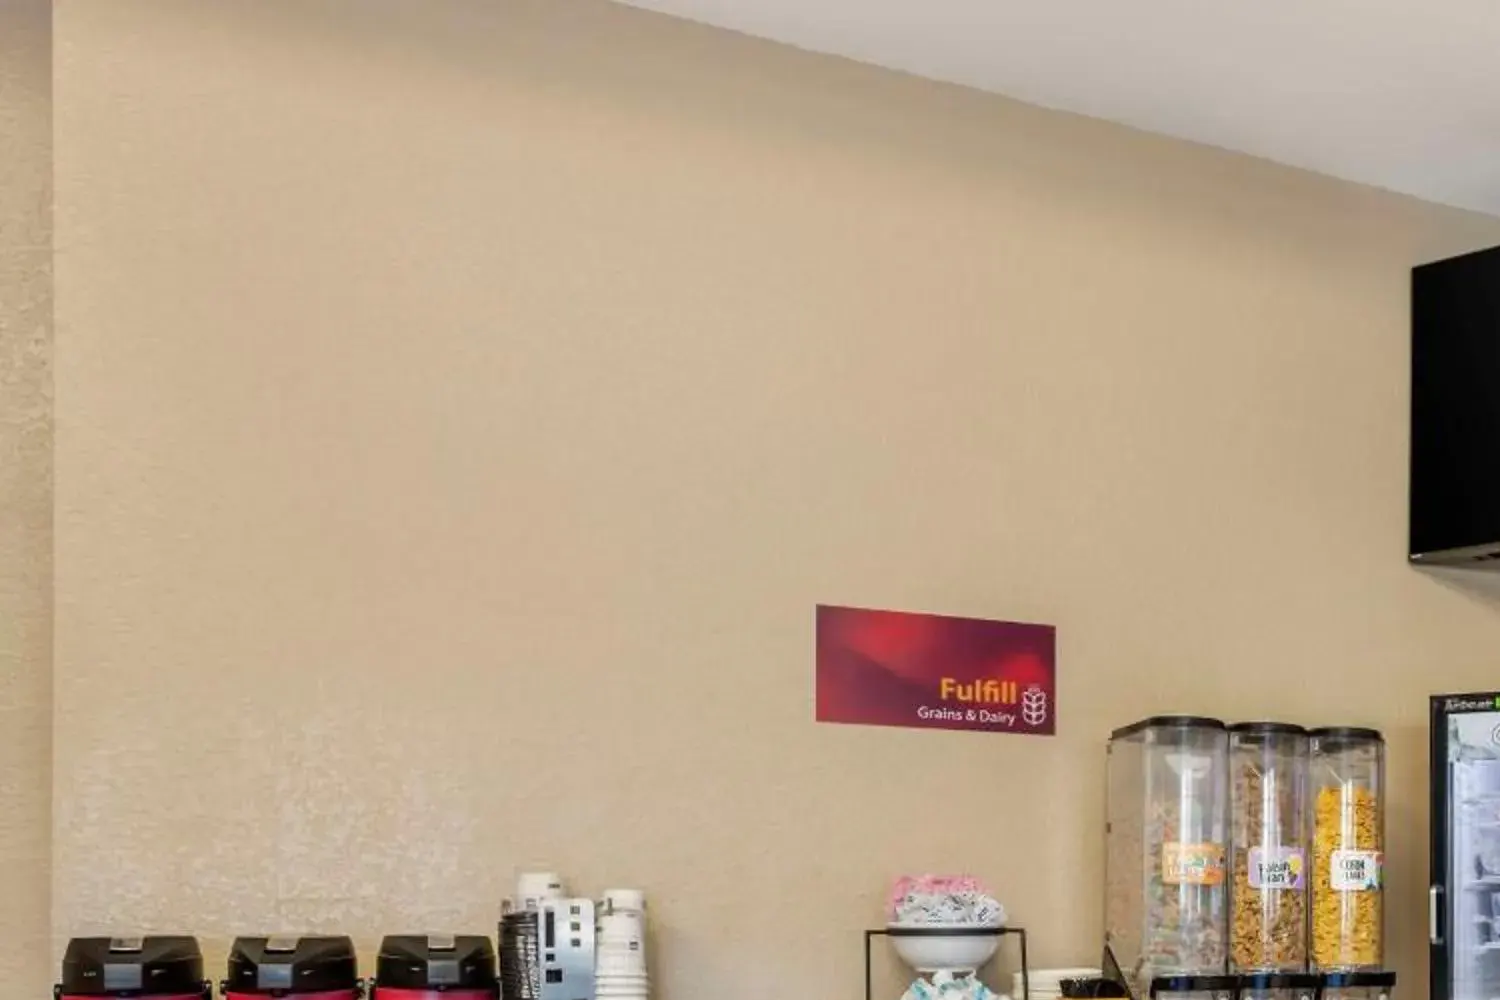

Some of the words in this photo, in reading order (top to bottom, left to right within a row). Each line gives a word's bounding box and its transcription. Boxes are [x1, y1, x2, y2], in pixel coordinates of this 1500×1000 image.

[941, 677, 1017, 704] Fulfill
[917, 705, 963, 721] Grains
[965, 709, 977, 721] &
[979, 709, 1016, 726] Dairy
